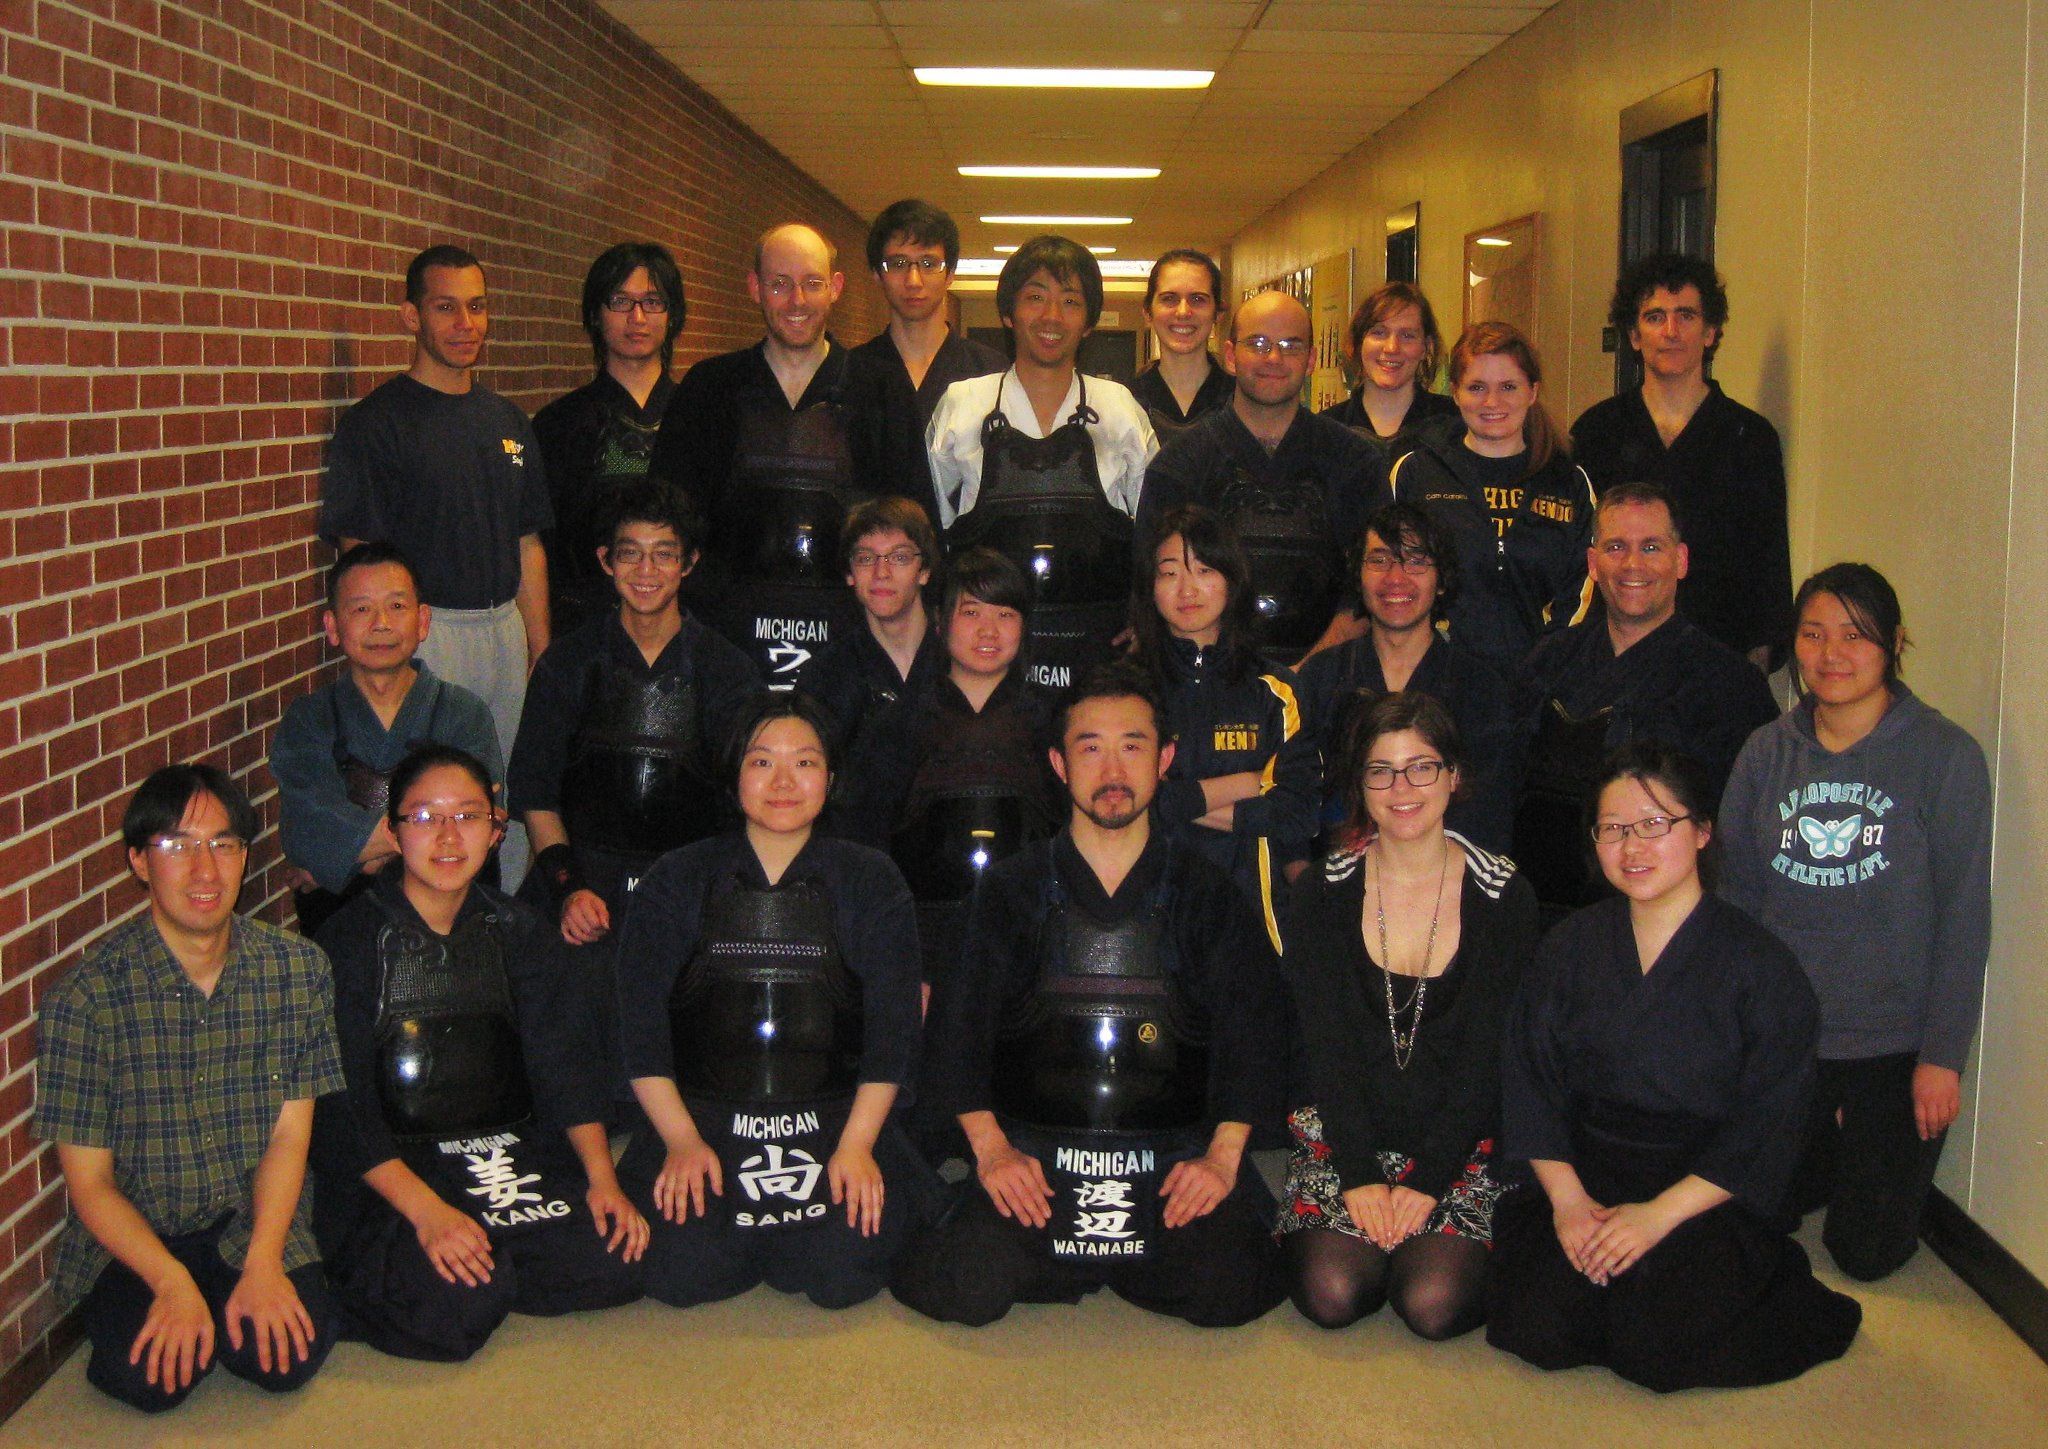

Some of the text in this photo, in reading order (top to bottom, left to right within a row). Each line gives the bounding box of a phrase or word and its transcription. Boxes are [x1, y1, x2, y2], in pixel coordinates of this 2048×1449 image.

[755, 617, 828, 642] MICHIGAN
[1862, 824, 1884, 846] 87
[732, 1110, 820, 1140] MICHIGAN
[1056, 1146, 1155, 1177] MICHIGAN
[481, 1199, 572, 1227] KANG
[735, 1203, 827, 1227] SANG
[1053, 1239, 1146, 1256] WATANABE
